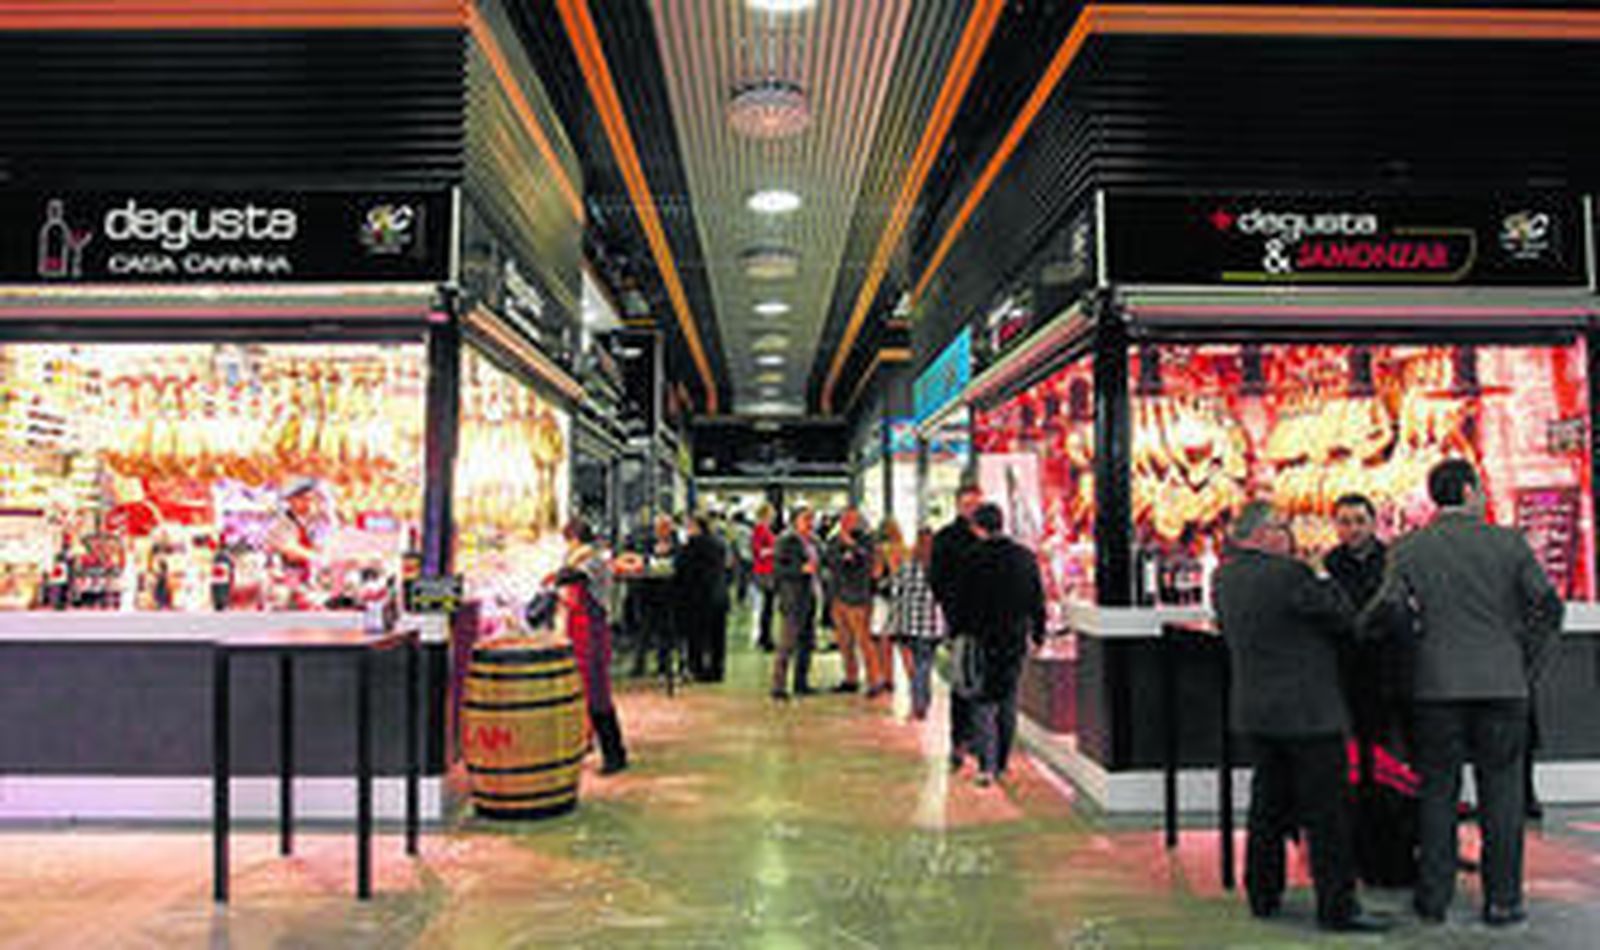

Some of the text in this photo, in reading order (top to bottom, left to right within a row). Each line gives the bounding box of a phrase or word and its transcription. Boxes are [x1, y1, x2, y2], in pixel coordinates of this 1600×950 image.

[104, 198, 297, 250] degusta
[1237, 208, 1378, 243] degusta
[107, 253, 178, 273] CASA
[1262, 238, 1292, 274] &
